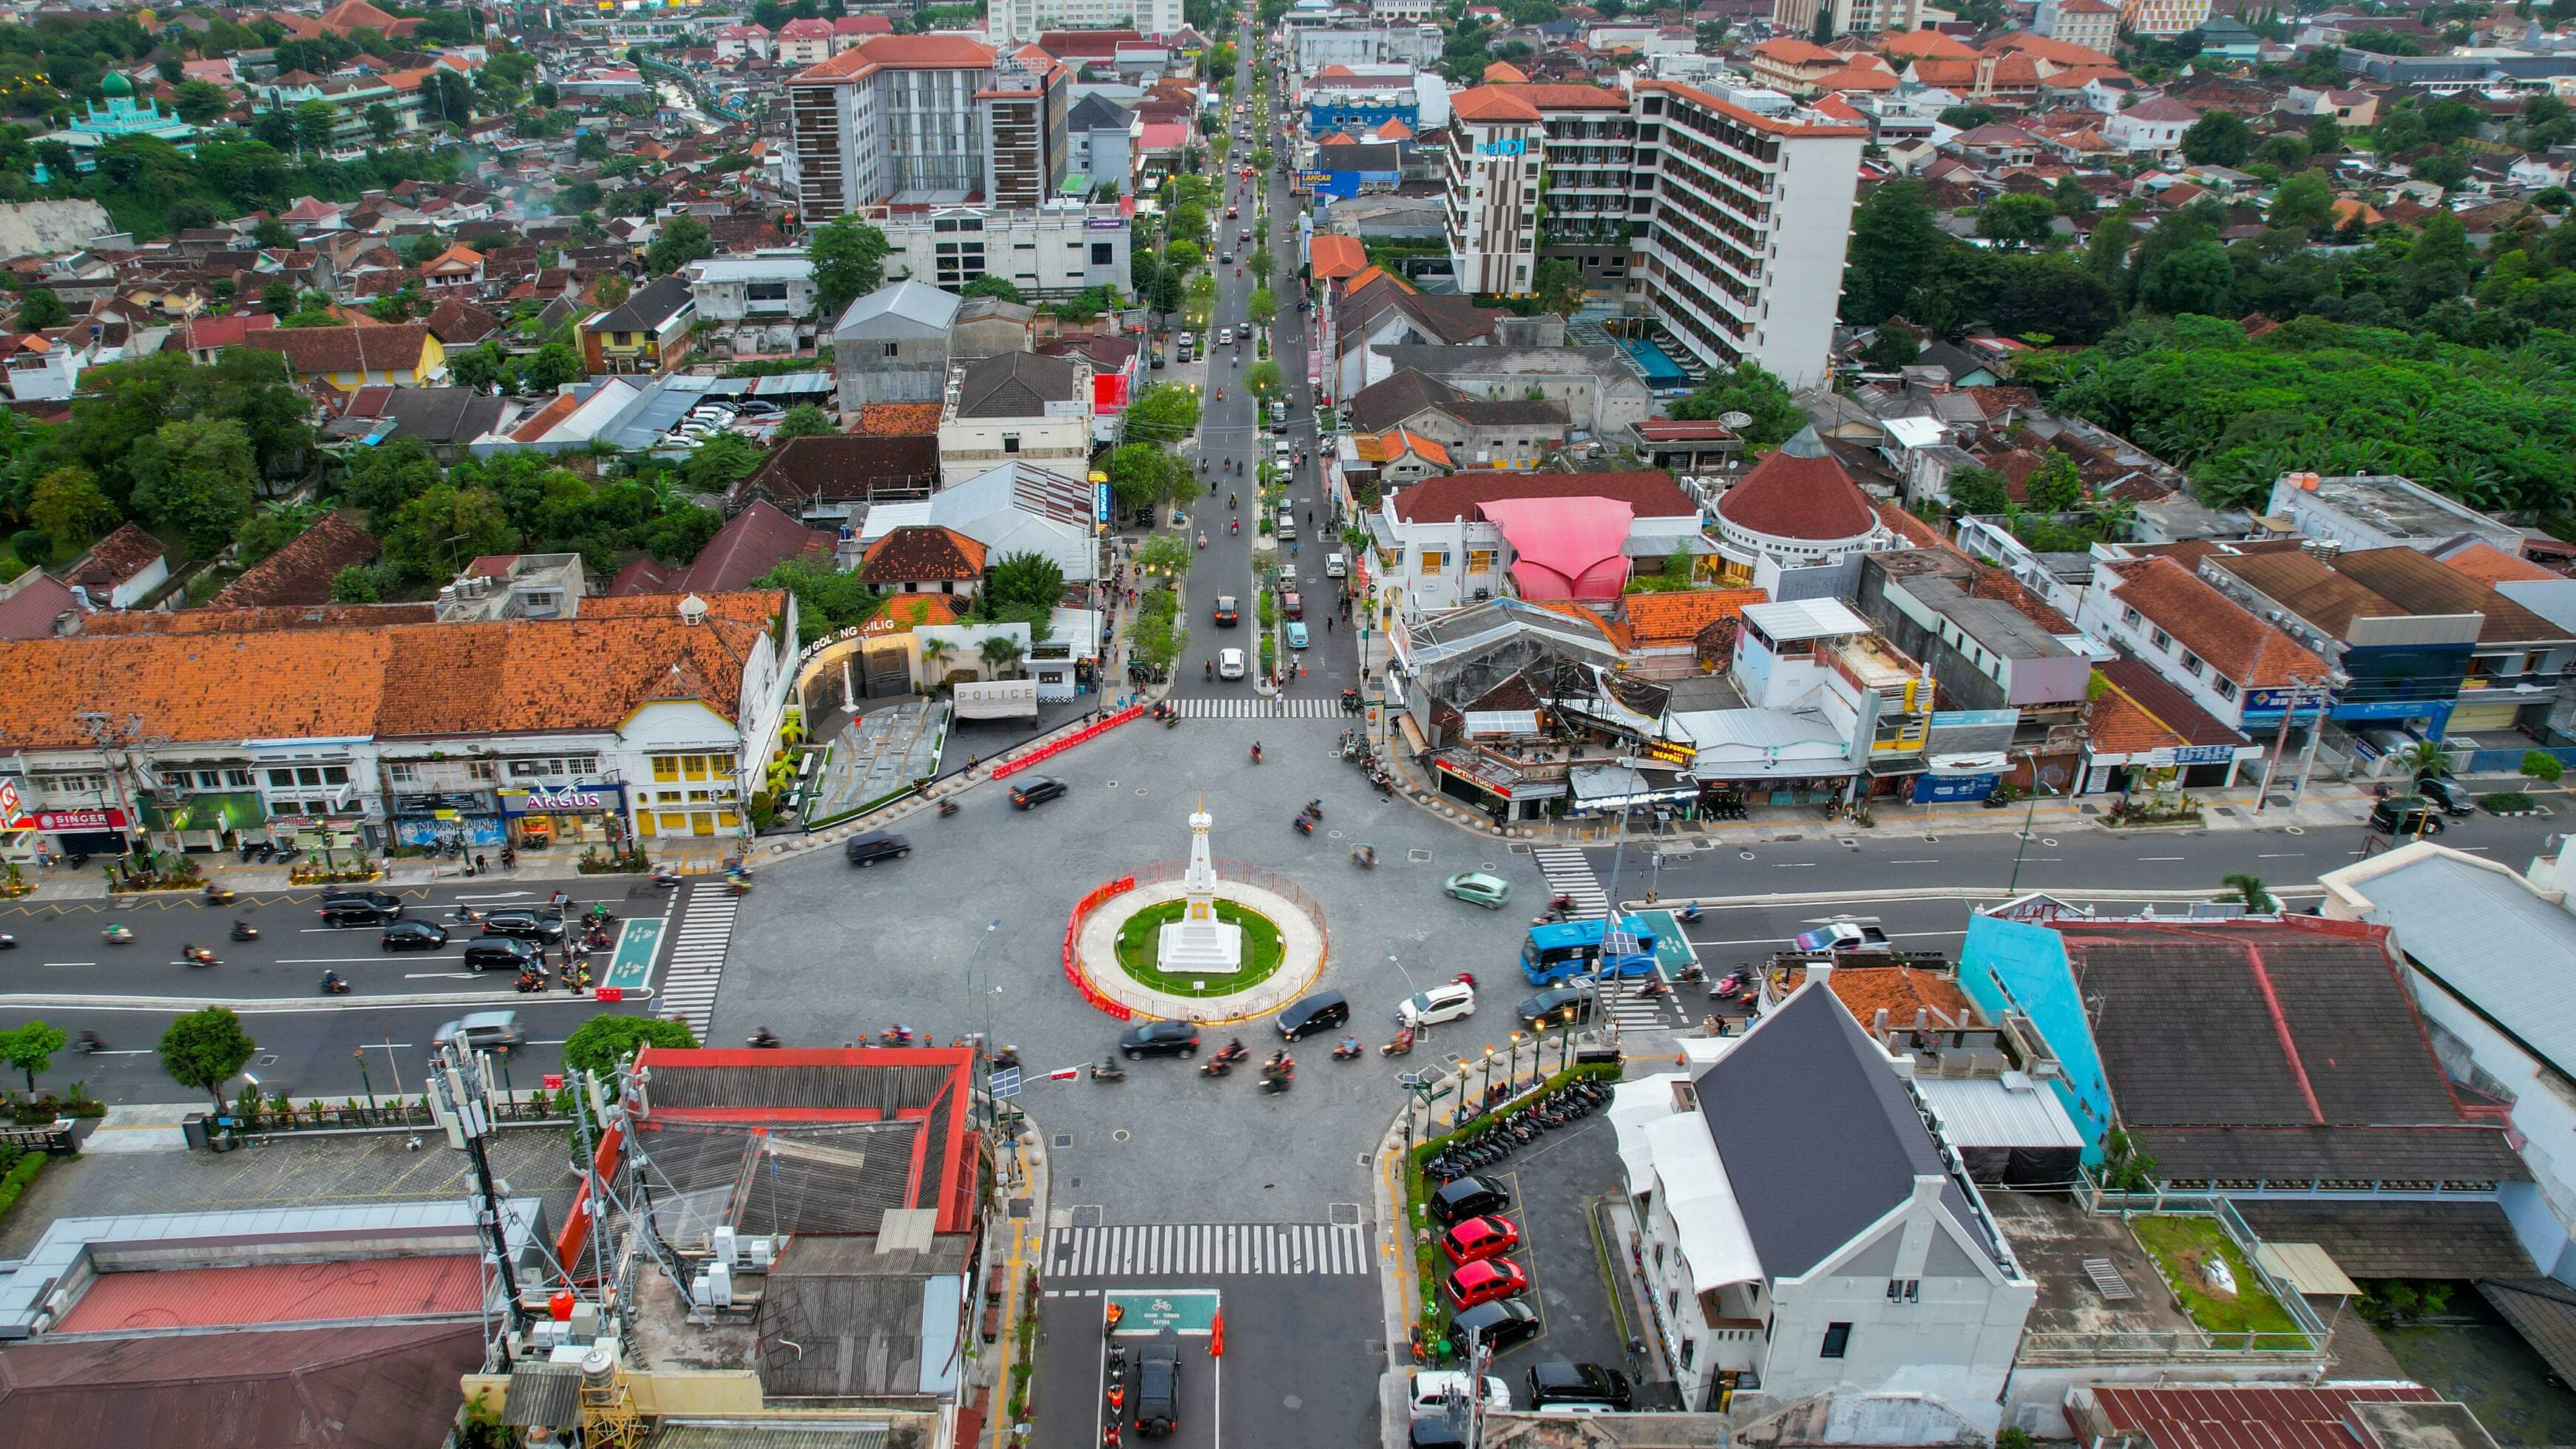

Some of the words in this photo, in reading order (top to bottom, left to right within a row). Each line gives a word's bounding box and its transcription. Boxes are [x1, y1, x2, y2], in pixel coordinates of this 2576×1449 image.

[992, 57, 1048, 70] HARPER
[1476, 142, 1497, 155] THE
[1498, 138, 1526, 155] 101
[958, 688, 1033, 701] POLICE
[1451, 766, 1475, 782] OPTIK
[1474, 778, 1495, 790] TUGU
[526, 793, 600, 810] ARGUS
[56, 815, 107, 824] SINGER
